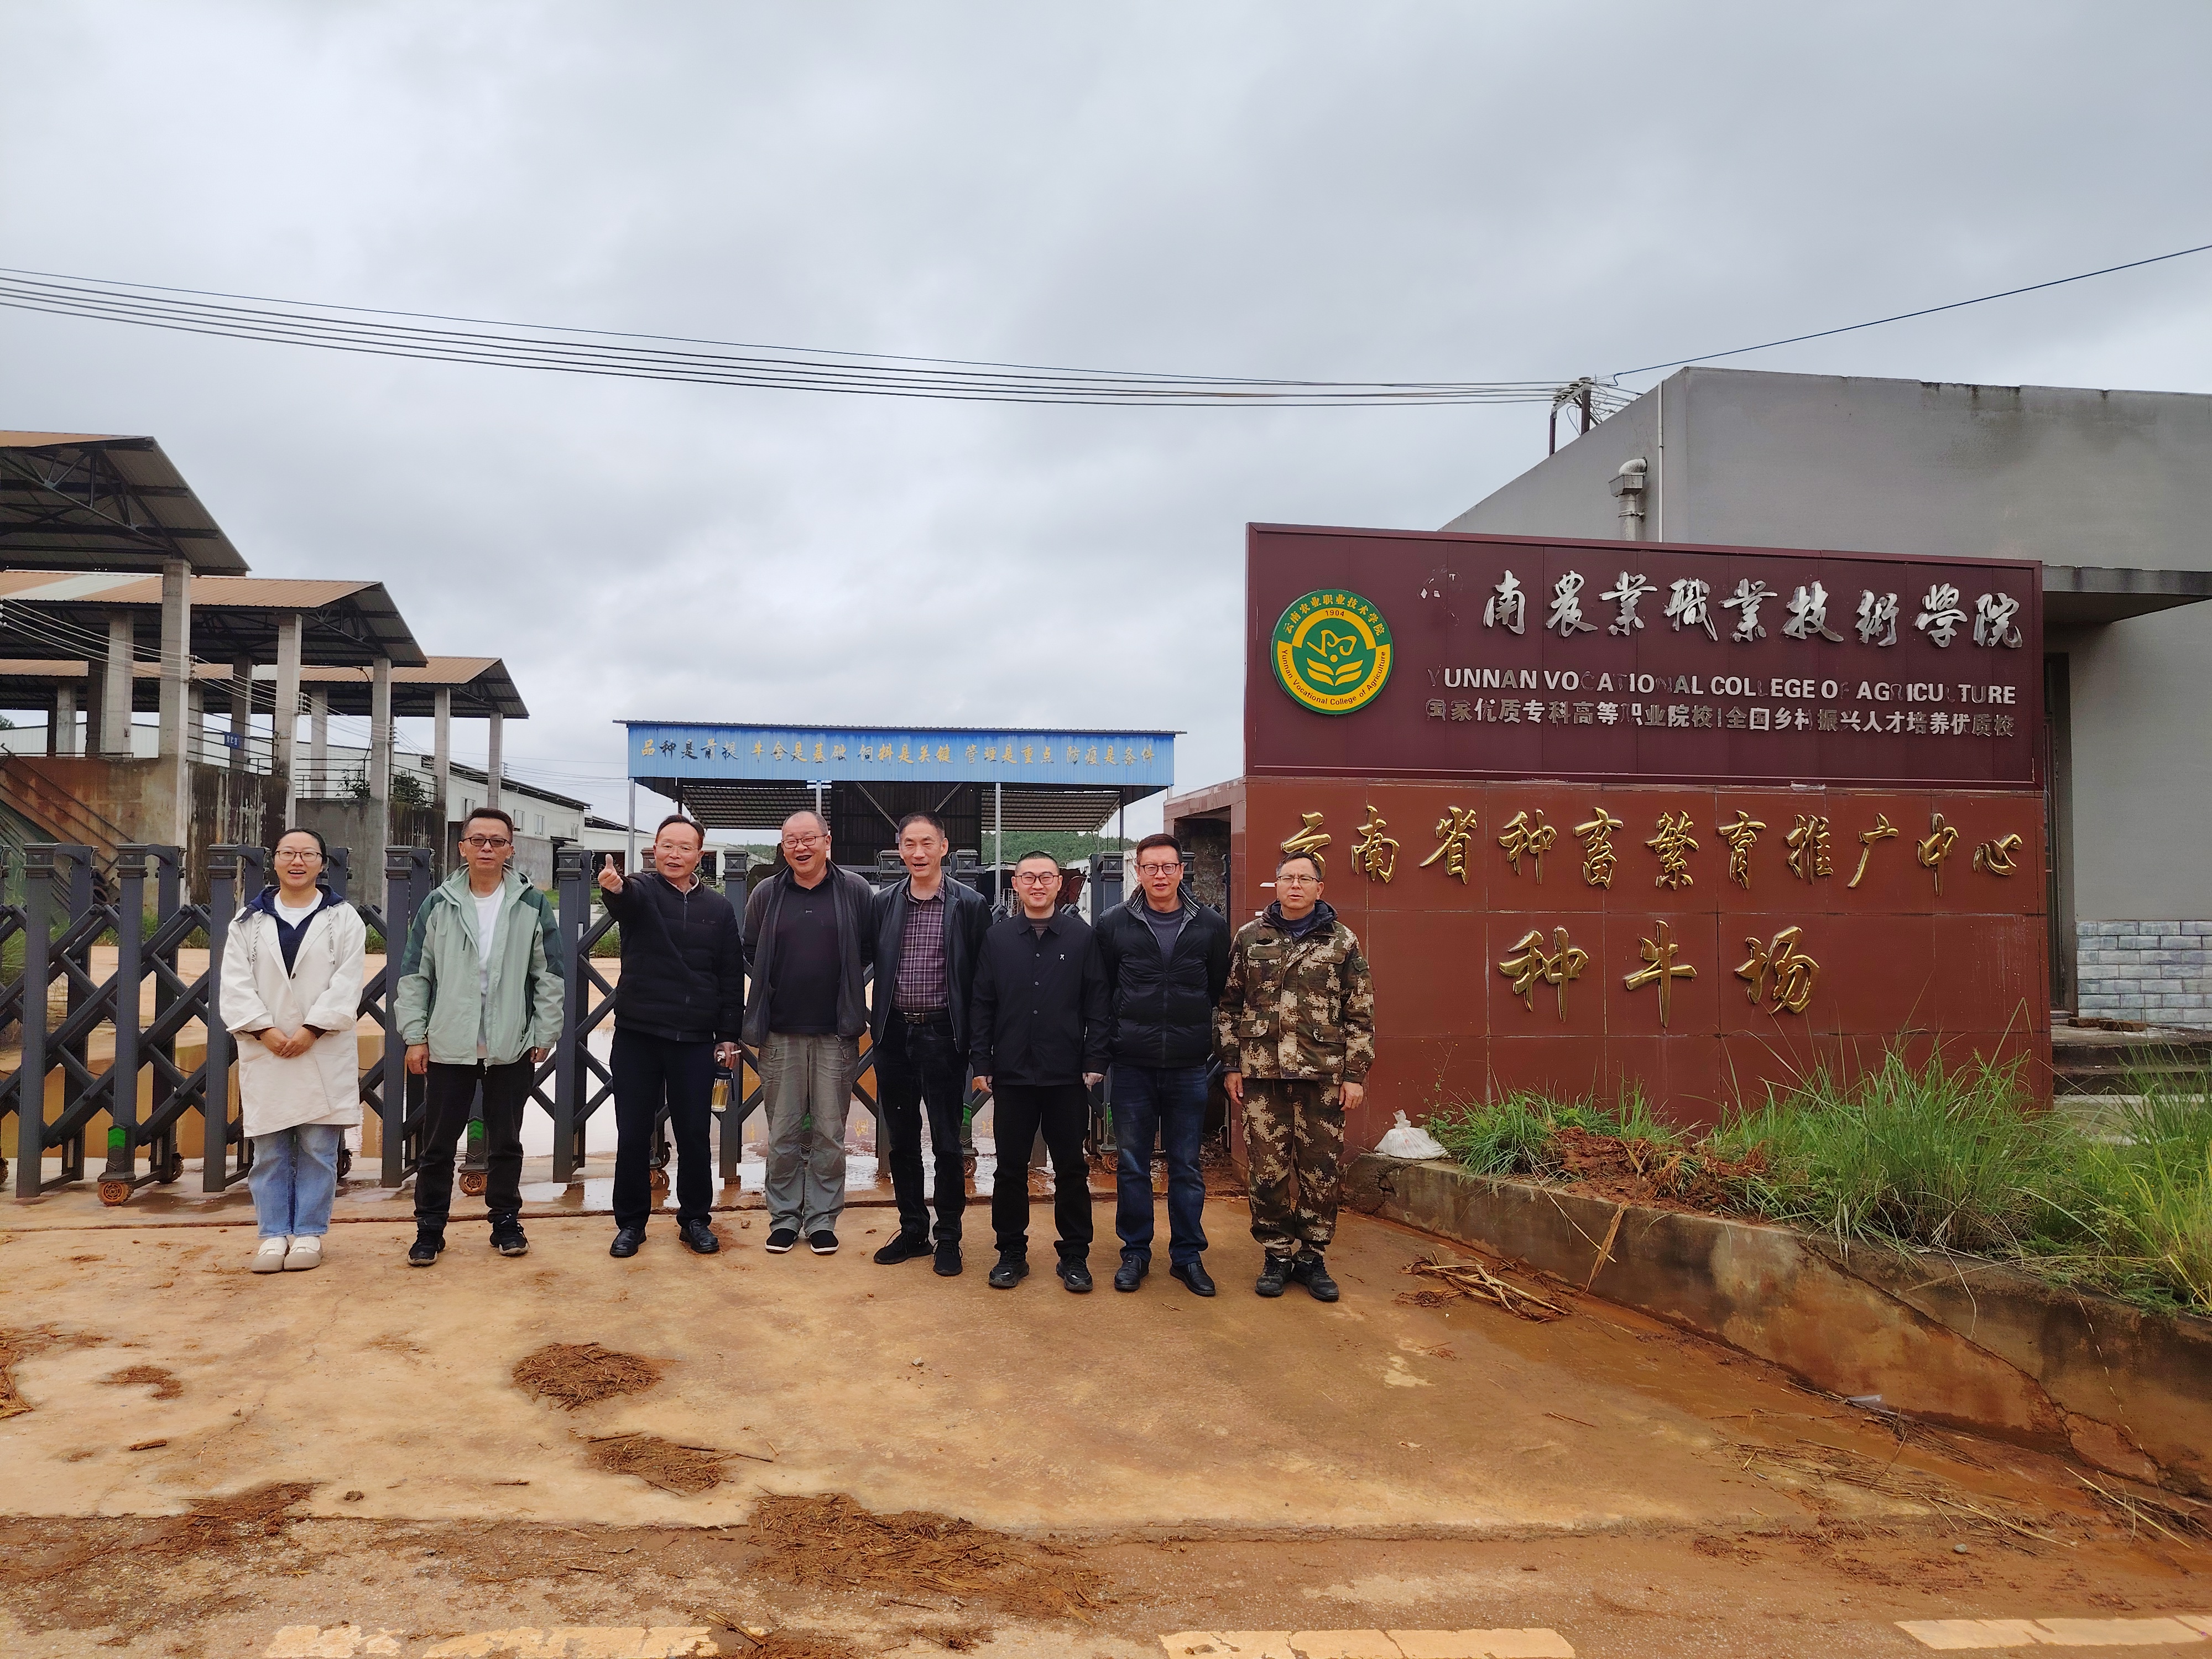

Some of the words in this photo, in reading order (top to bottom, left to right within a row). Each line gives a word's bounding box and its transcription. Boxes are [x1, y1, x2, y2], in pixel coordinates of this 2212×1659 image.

[1284, 593, 1385, 636] 云南农业职业技术学院
[1417, 570, 2023, 648] 南農業職業技術學院
[1281, 649, 1293, 679] Yunnan
[1293, 679, 1328, 705] Vocational
[1330, 695, 1357, 705] College
[1366, 651, 1386, 691] Agriculture
[641, 738, 740, 761] 品种是前提
[751, 739, 847, 764] 牛舍是基础
[857, 742, 954, 766] 饲料是关键
[965, 743, 1055, 764] 管理是重点
[1066, 744, 1156, 767] 防疫是条件
[1498, 918, 1820, 1028] 种牛场
